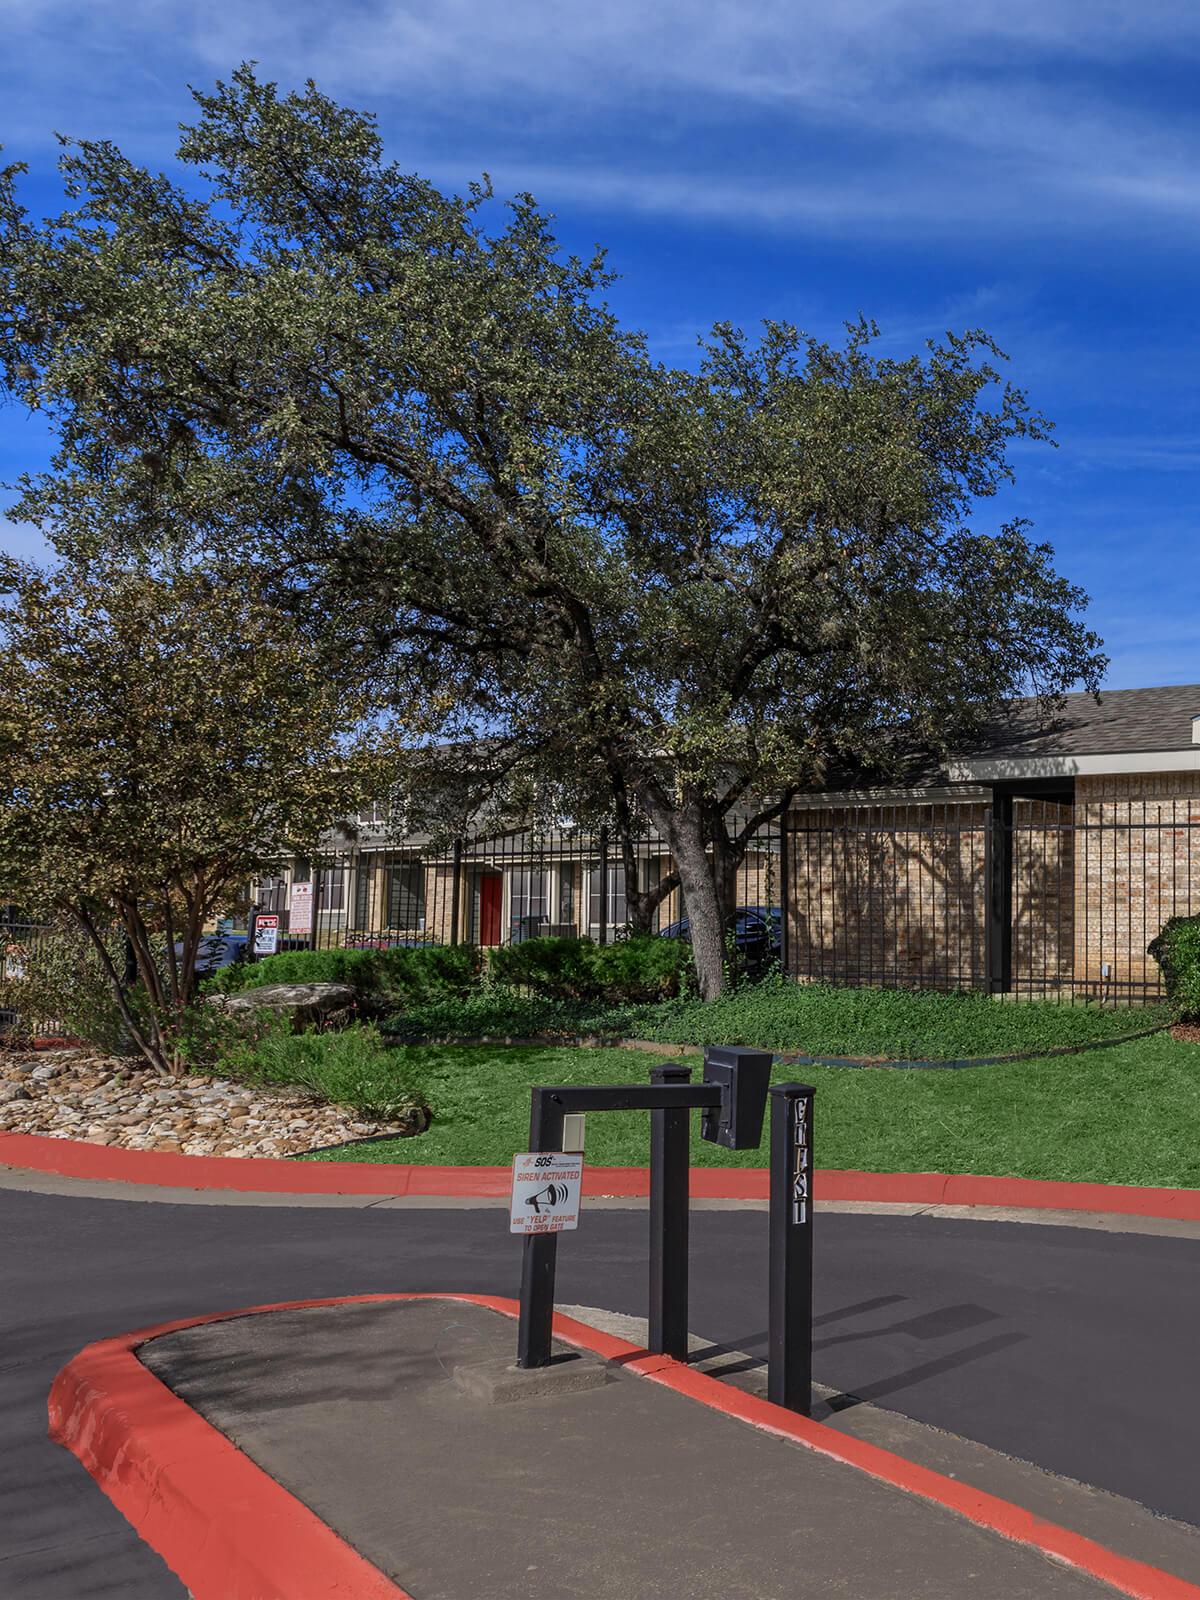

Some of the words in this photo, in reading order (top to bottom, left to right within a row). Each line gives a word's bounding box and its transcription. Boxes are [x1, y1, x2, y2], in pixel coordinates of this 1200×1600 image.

[534, 1157, 553, 1167] SOS
[517, 1172, 540, 1181] SIREN
[541, 1171, 579, 1180] ACTIVATED
[512, 1217, 525, 1225] USE
[524, 1224, 532, 1232] TO
